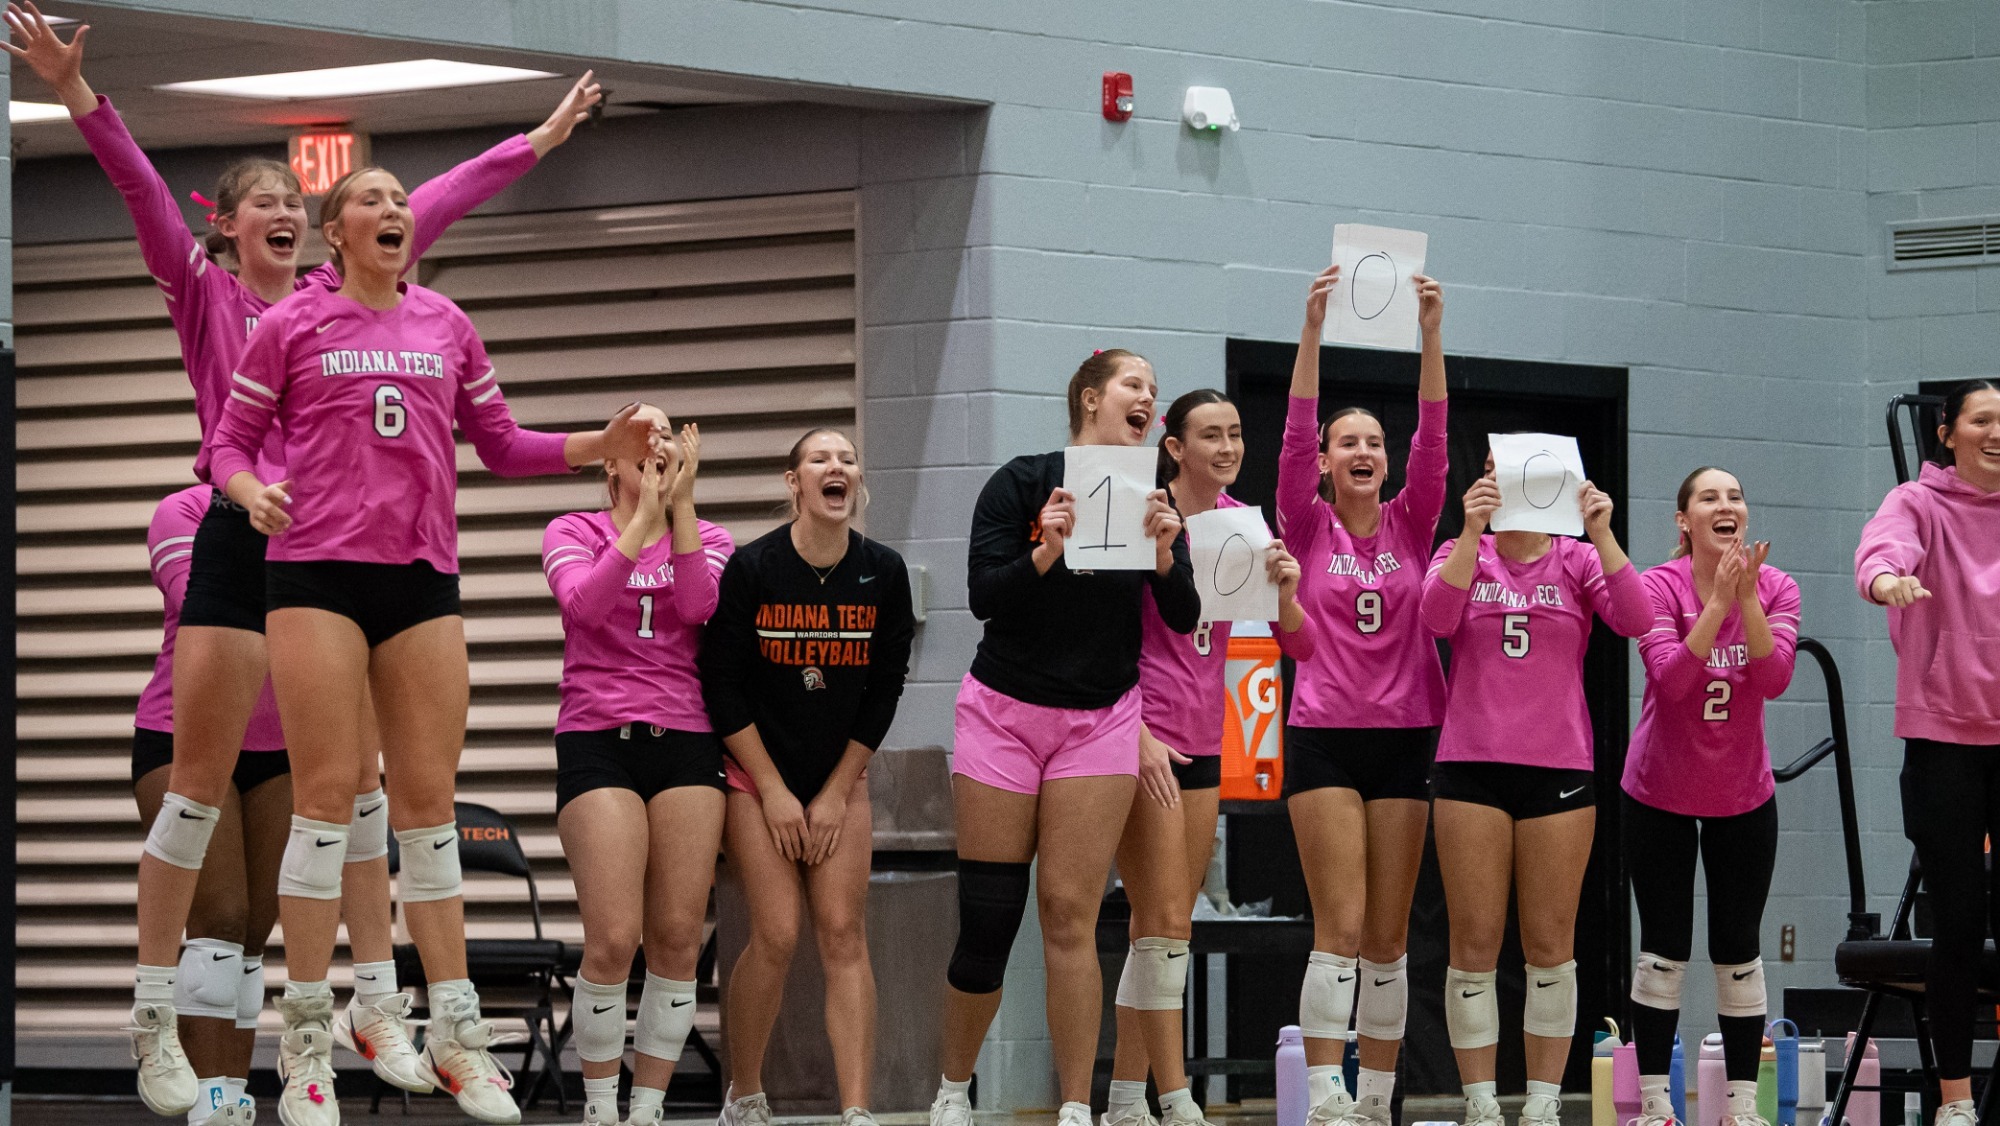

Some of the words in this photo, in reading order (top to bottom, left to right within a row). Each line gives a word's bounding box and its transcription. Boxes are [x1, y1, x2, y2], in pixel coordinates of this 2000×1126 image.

[300, 134, 353, 192] EXIT
[320, 350, 399, 376] INDIANA
[400, 351, 444, 379] TECH
[373, 384, 407, 438] 6
[1078, 475, 1127, 552] 1
[1355, 591, 1383, 634] 9
[1471, 581, 1528, 608] INDIANA
[637, 594, 655, 639] 1
[755, 604, 830, 629] INDIANA
[836, 605, 877, 629] TECH
[797, 631, 839, 639] WARRIORS
[1502, 613, 1530, 659] 5
[759, 638, 870, 666] VOLLEYBALL
[1247, 666, 1277, 714] G
[1703, 679, 1731, 721] 2
[461, 827, 510, 841] TECH
